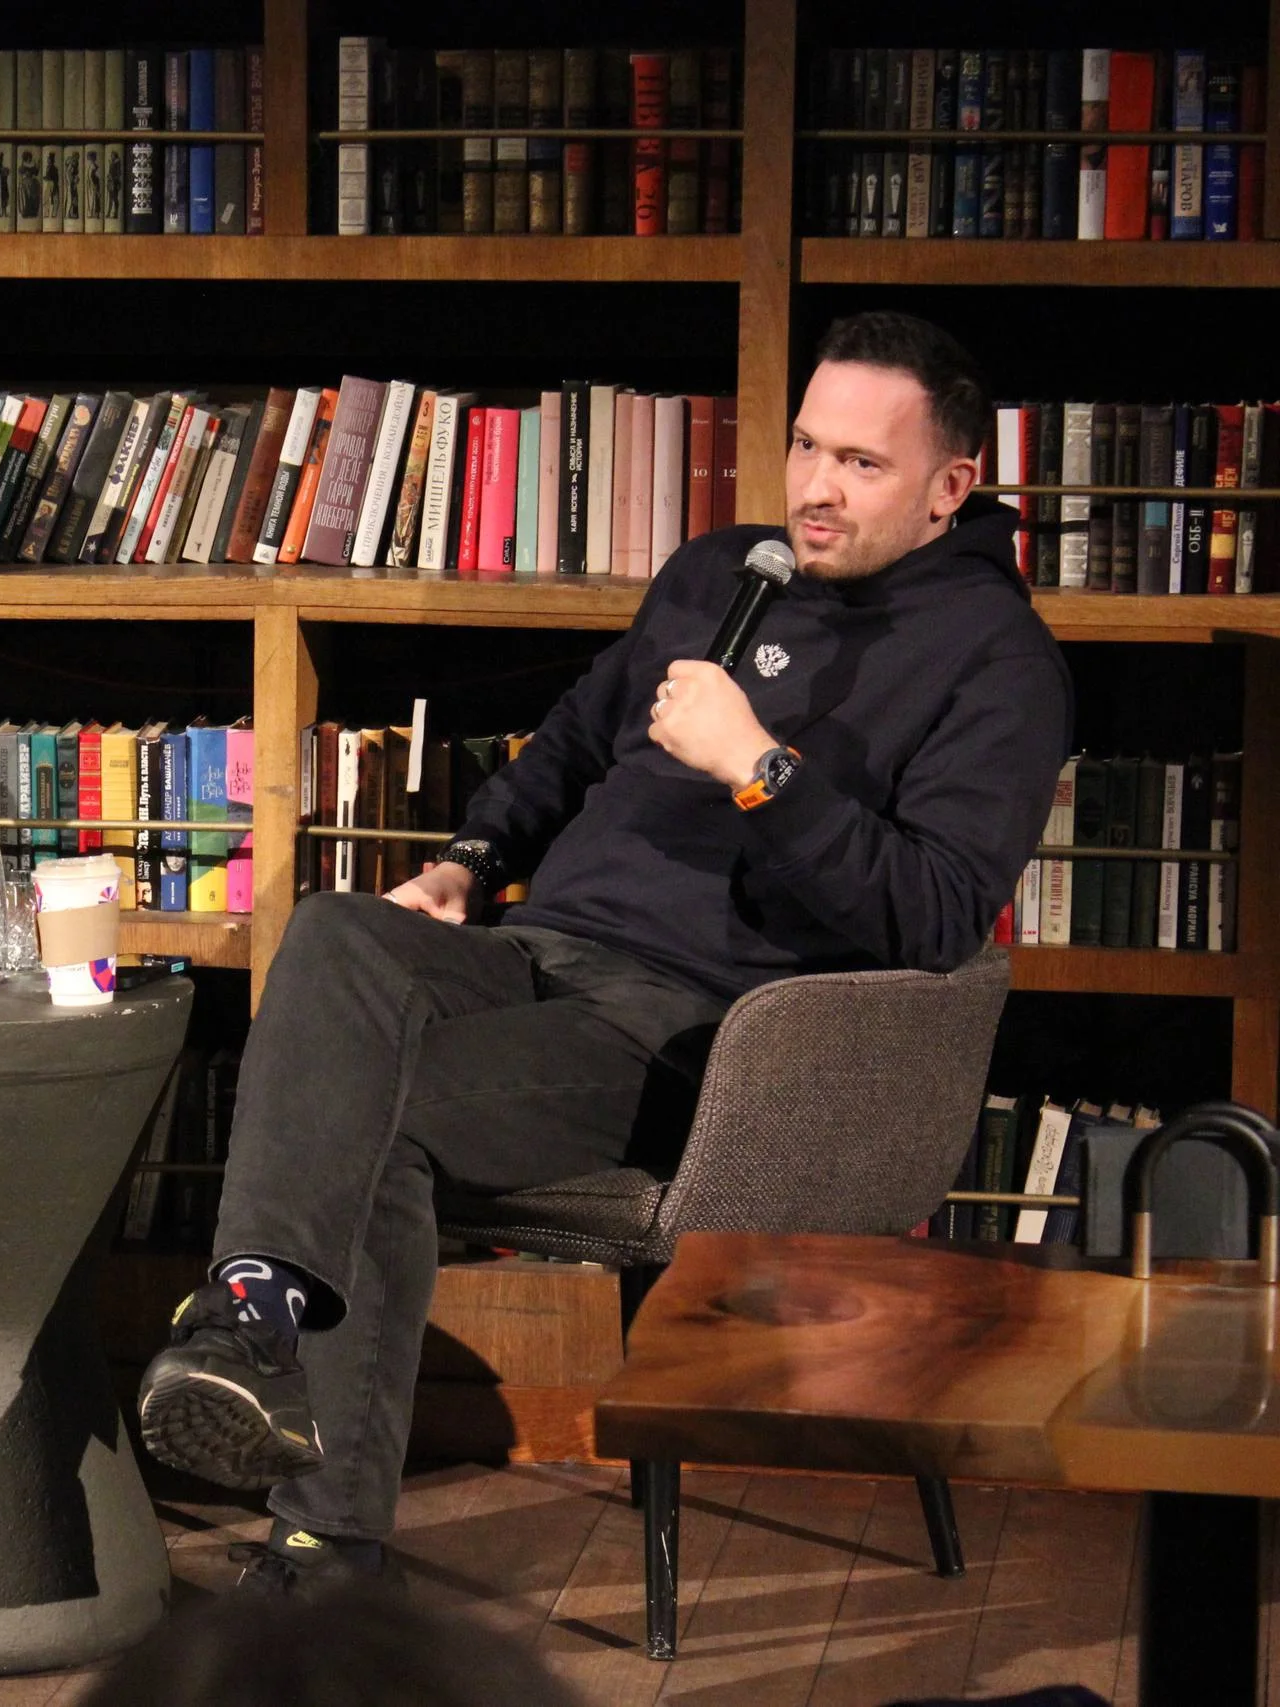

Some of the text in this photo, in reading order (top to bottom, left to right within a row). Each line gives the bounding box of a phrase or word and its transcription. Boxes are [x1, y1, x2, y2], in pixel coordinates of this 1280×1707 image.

[251, 94, 262, 133] РАТЬЯ
[1180, 143, 1193, 211] ОНЧАРОВ
[567, 391, 578, 437] НАЗНАЧЕНИЕ
[110, 414, 141, 485] ФОЛКНЕР
[335, 431, 367, 458] ПРАВДА
[422, 400, 456, 531] МИШЕЛЬ ФУКО
[568, 443, 577, 471] СМЫСЛ
[573, 437, 584, 471] ИСТОРИИ
[340, 460, 361, 485] ДЕЛЕ
[692, 468, 708, 478] 10
[723, 468, 736, 478] 12
[1174, 448, 1185, 487] ДЕФИЛЕ
[264, 468, 291, 539] КНИГА ТЕМНОЙ ВОДЫ
[327, 484, 354, 507] ГАРРИ
[361, 468, 388, 549] ПРИКЛЮЧЕНИЯ
[569, 484, 579, 532] КАРЛ ЯСПЕРС
[1171, 502, 1183, 564] Сергей Плото
[19, 742, 31, 813] ДРАЙЗЕР
[139, 744, 149, 775] власти
[139, 781, 150, 804] Путь
[161, 742, 172, 841] АЛСАНДР БАШЛАЧЁВ
[135, 804, 149, 849] Стаин.
